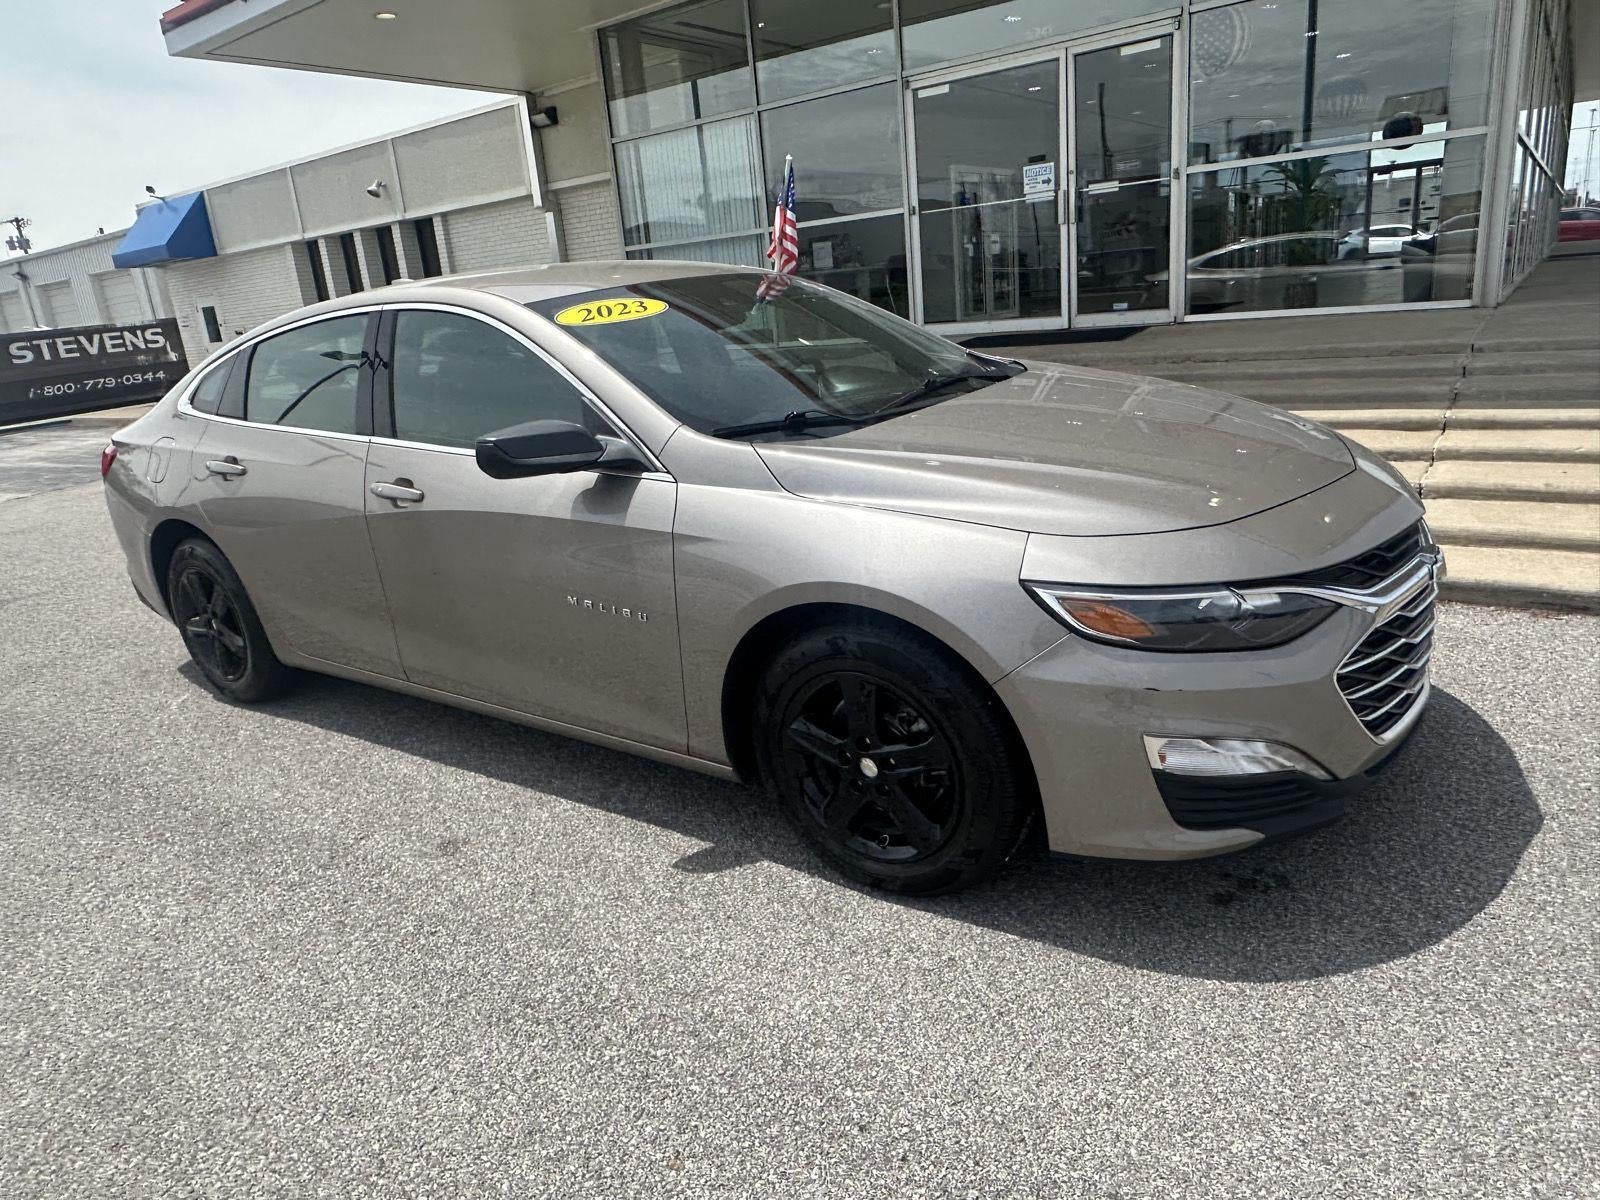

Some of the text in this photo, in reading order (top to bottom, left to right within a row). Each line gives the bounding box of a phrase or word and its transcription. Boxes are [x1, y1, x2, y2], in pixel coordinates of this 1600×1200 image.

[1025, 166, 1052, 178] NOTICE
[577, 300, 649, 323] 2023
[8, 327, 166, 364] STEVENS
[567, 595, 647, 622] MALIBU
